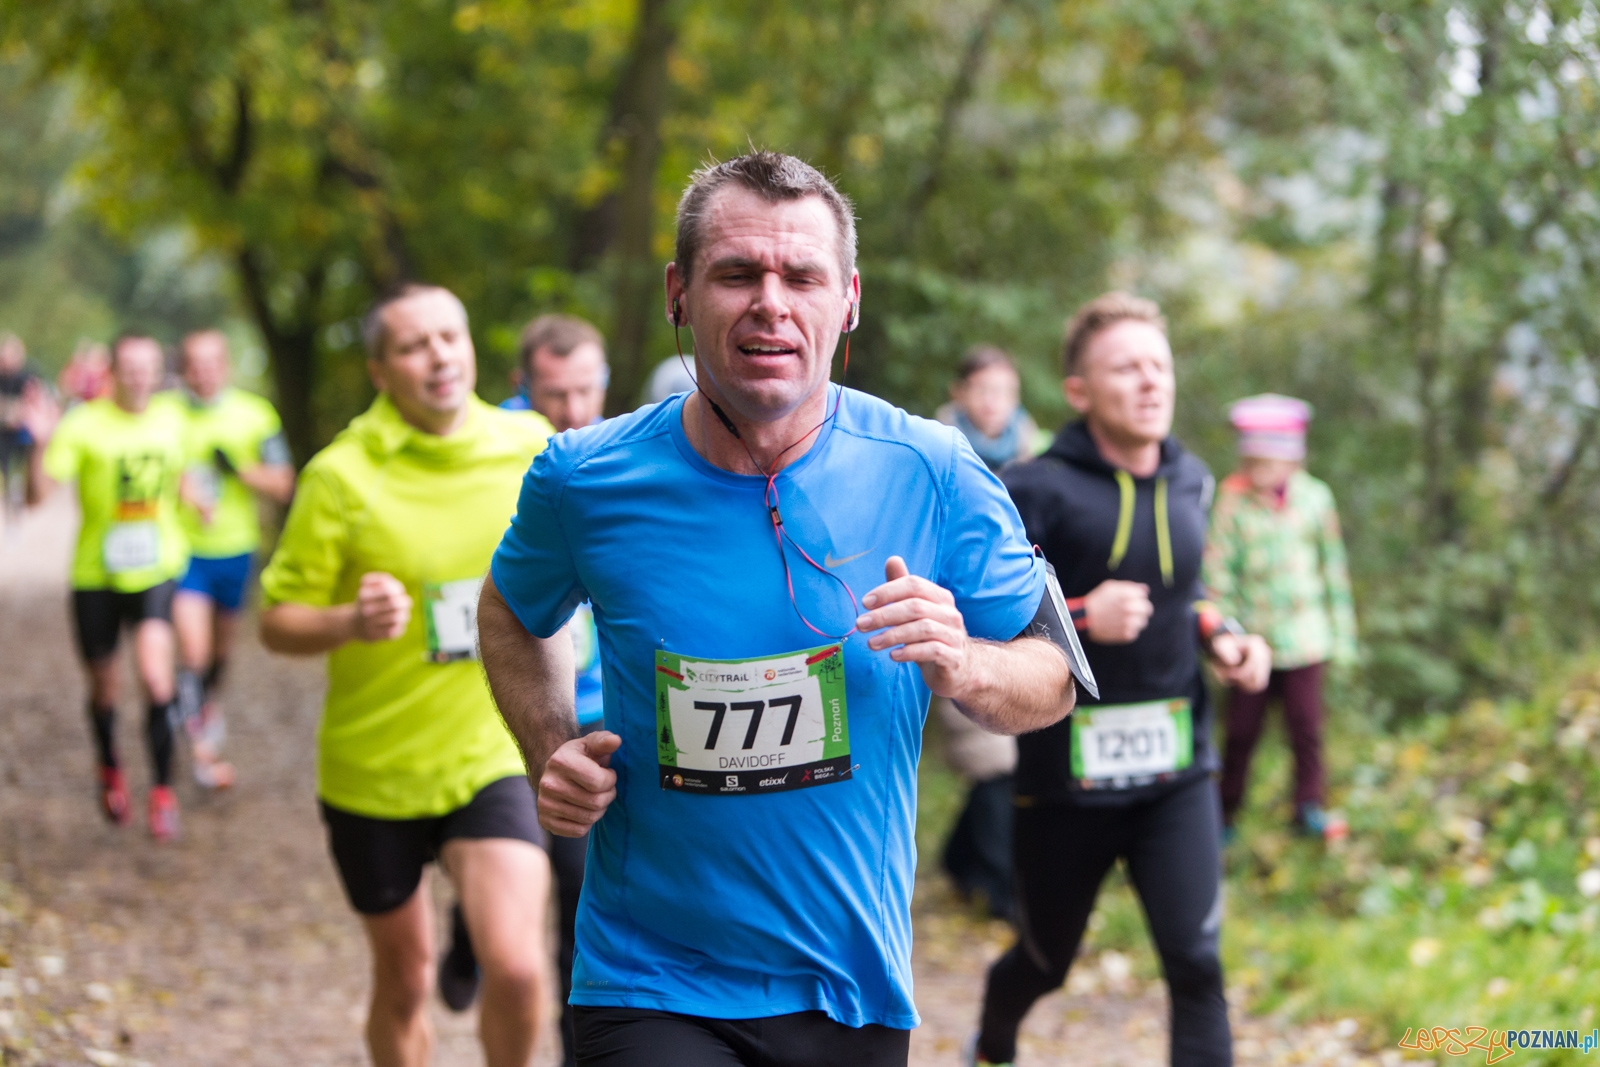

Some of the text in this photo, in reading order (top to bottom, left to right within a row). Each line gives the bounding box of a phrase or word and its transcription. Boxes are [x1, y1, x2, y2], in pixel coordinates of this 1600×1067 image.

[693, 694, 803, 750] 777
[831, 698, 842, 742] Poznań
[719, 752, 786, 769] DAVIDOFF
[1097, 727, 1169, 760] 1201
